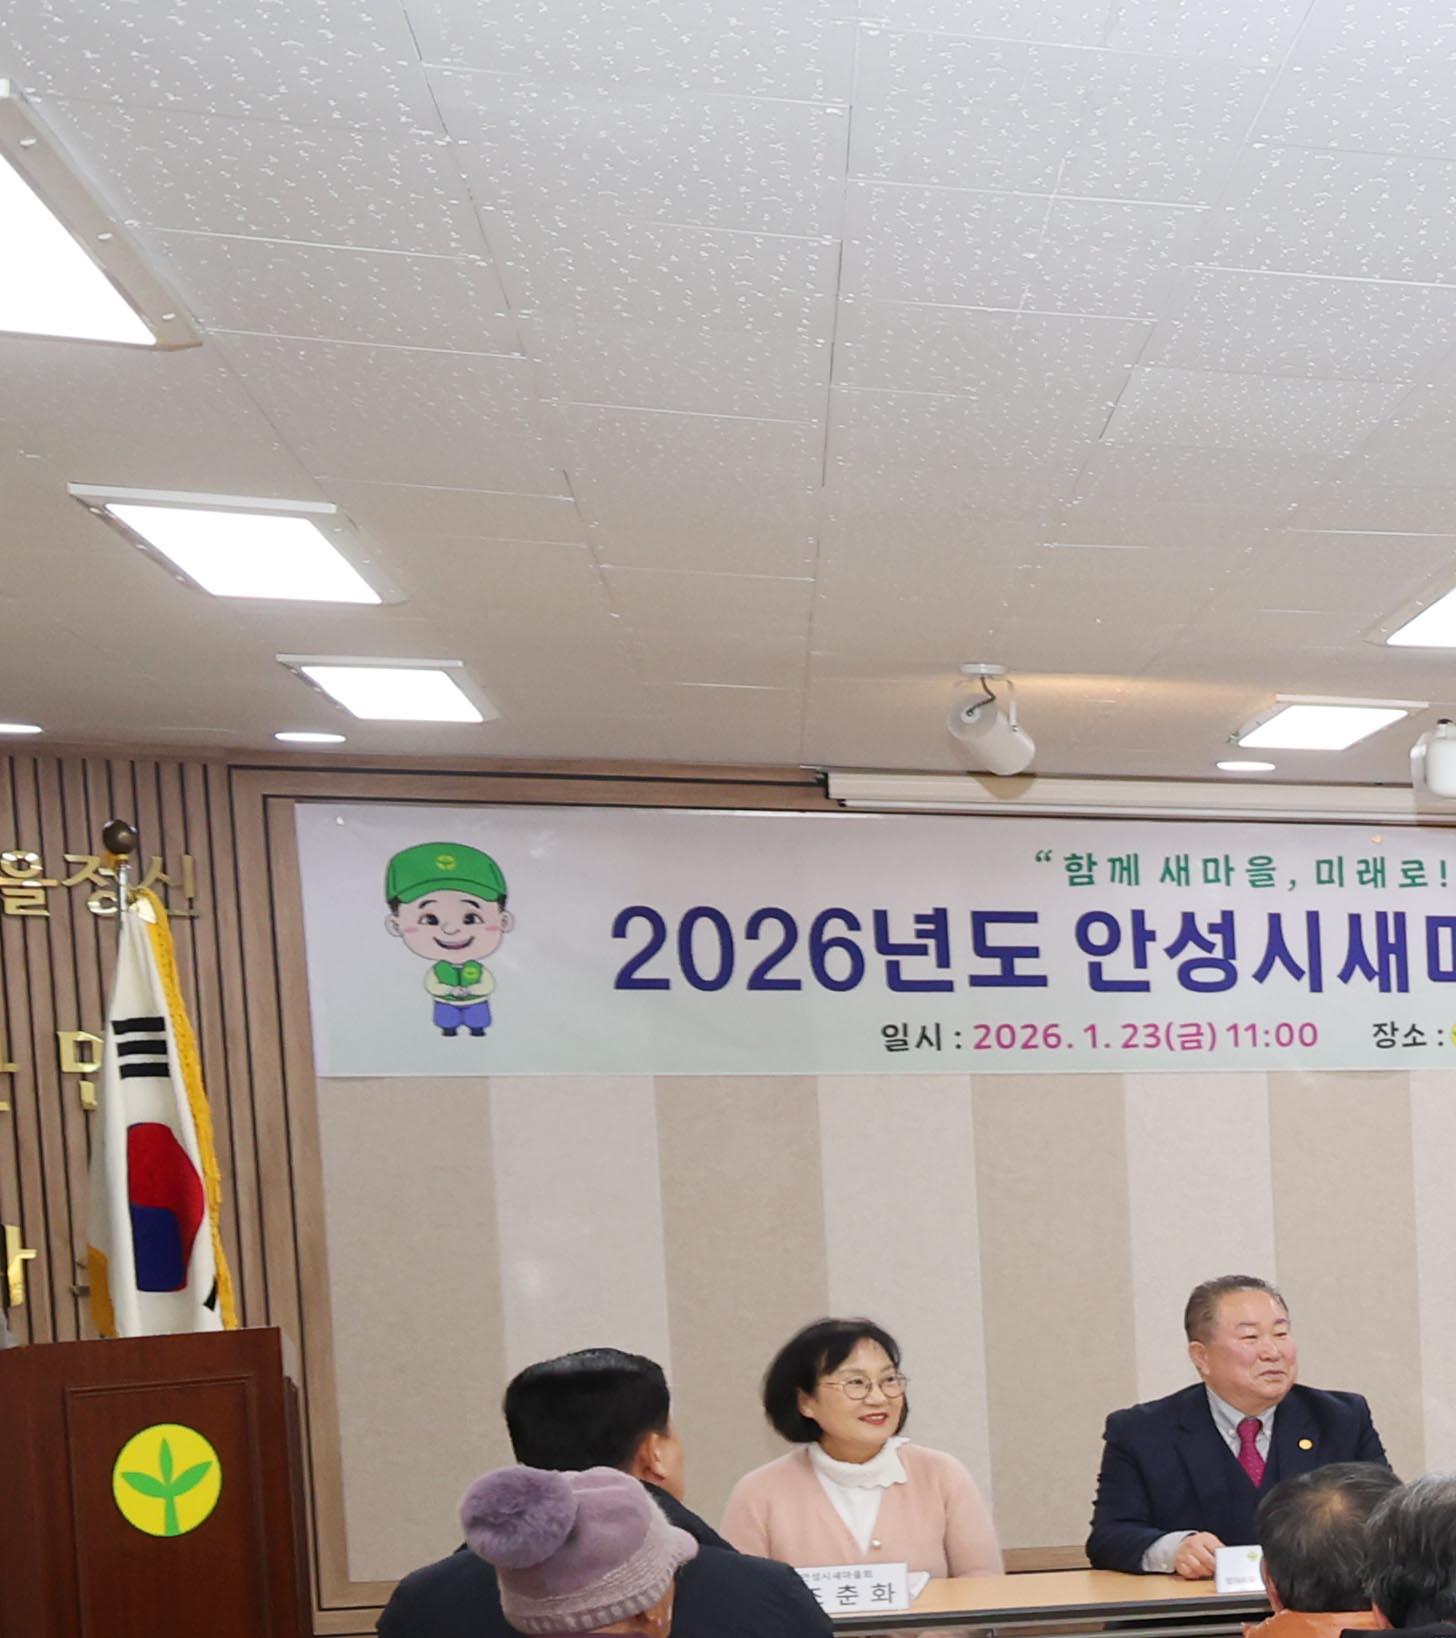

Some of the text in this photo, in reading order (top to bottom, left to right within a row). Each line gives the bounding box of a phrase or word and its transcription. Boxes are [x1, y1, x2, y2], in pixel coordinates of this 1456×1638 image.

[1159, 854, 1297, 892] 새마을,
[1315, 856, 1448, 889] 미래로!
[610, 905, 1049, 993] 2026년도
[1120, 1021, 1217, 1052] 23(금)
[1225, 1021, 1318, 1048] 11:00
